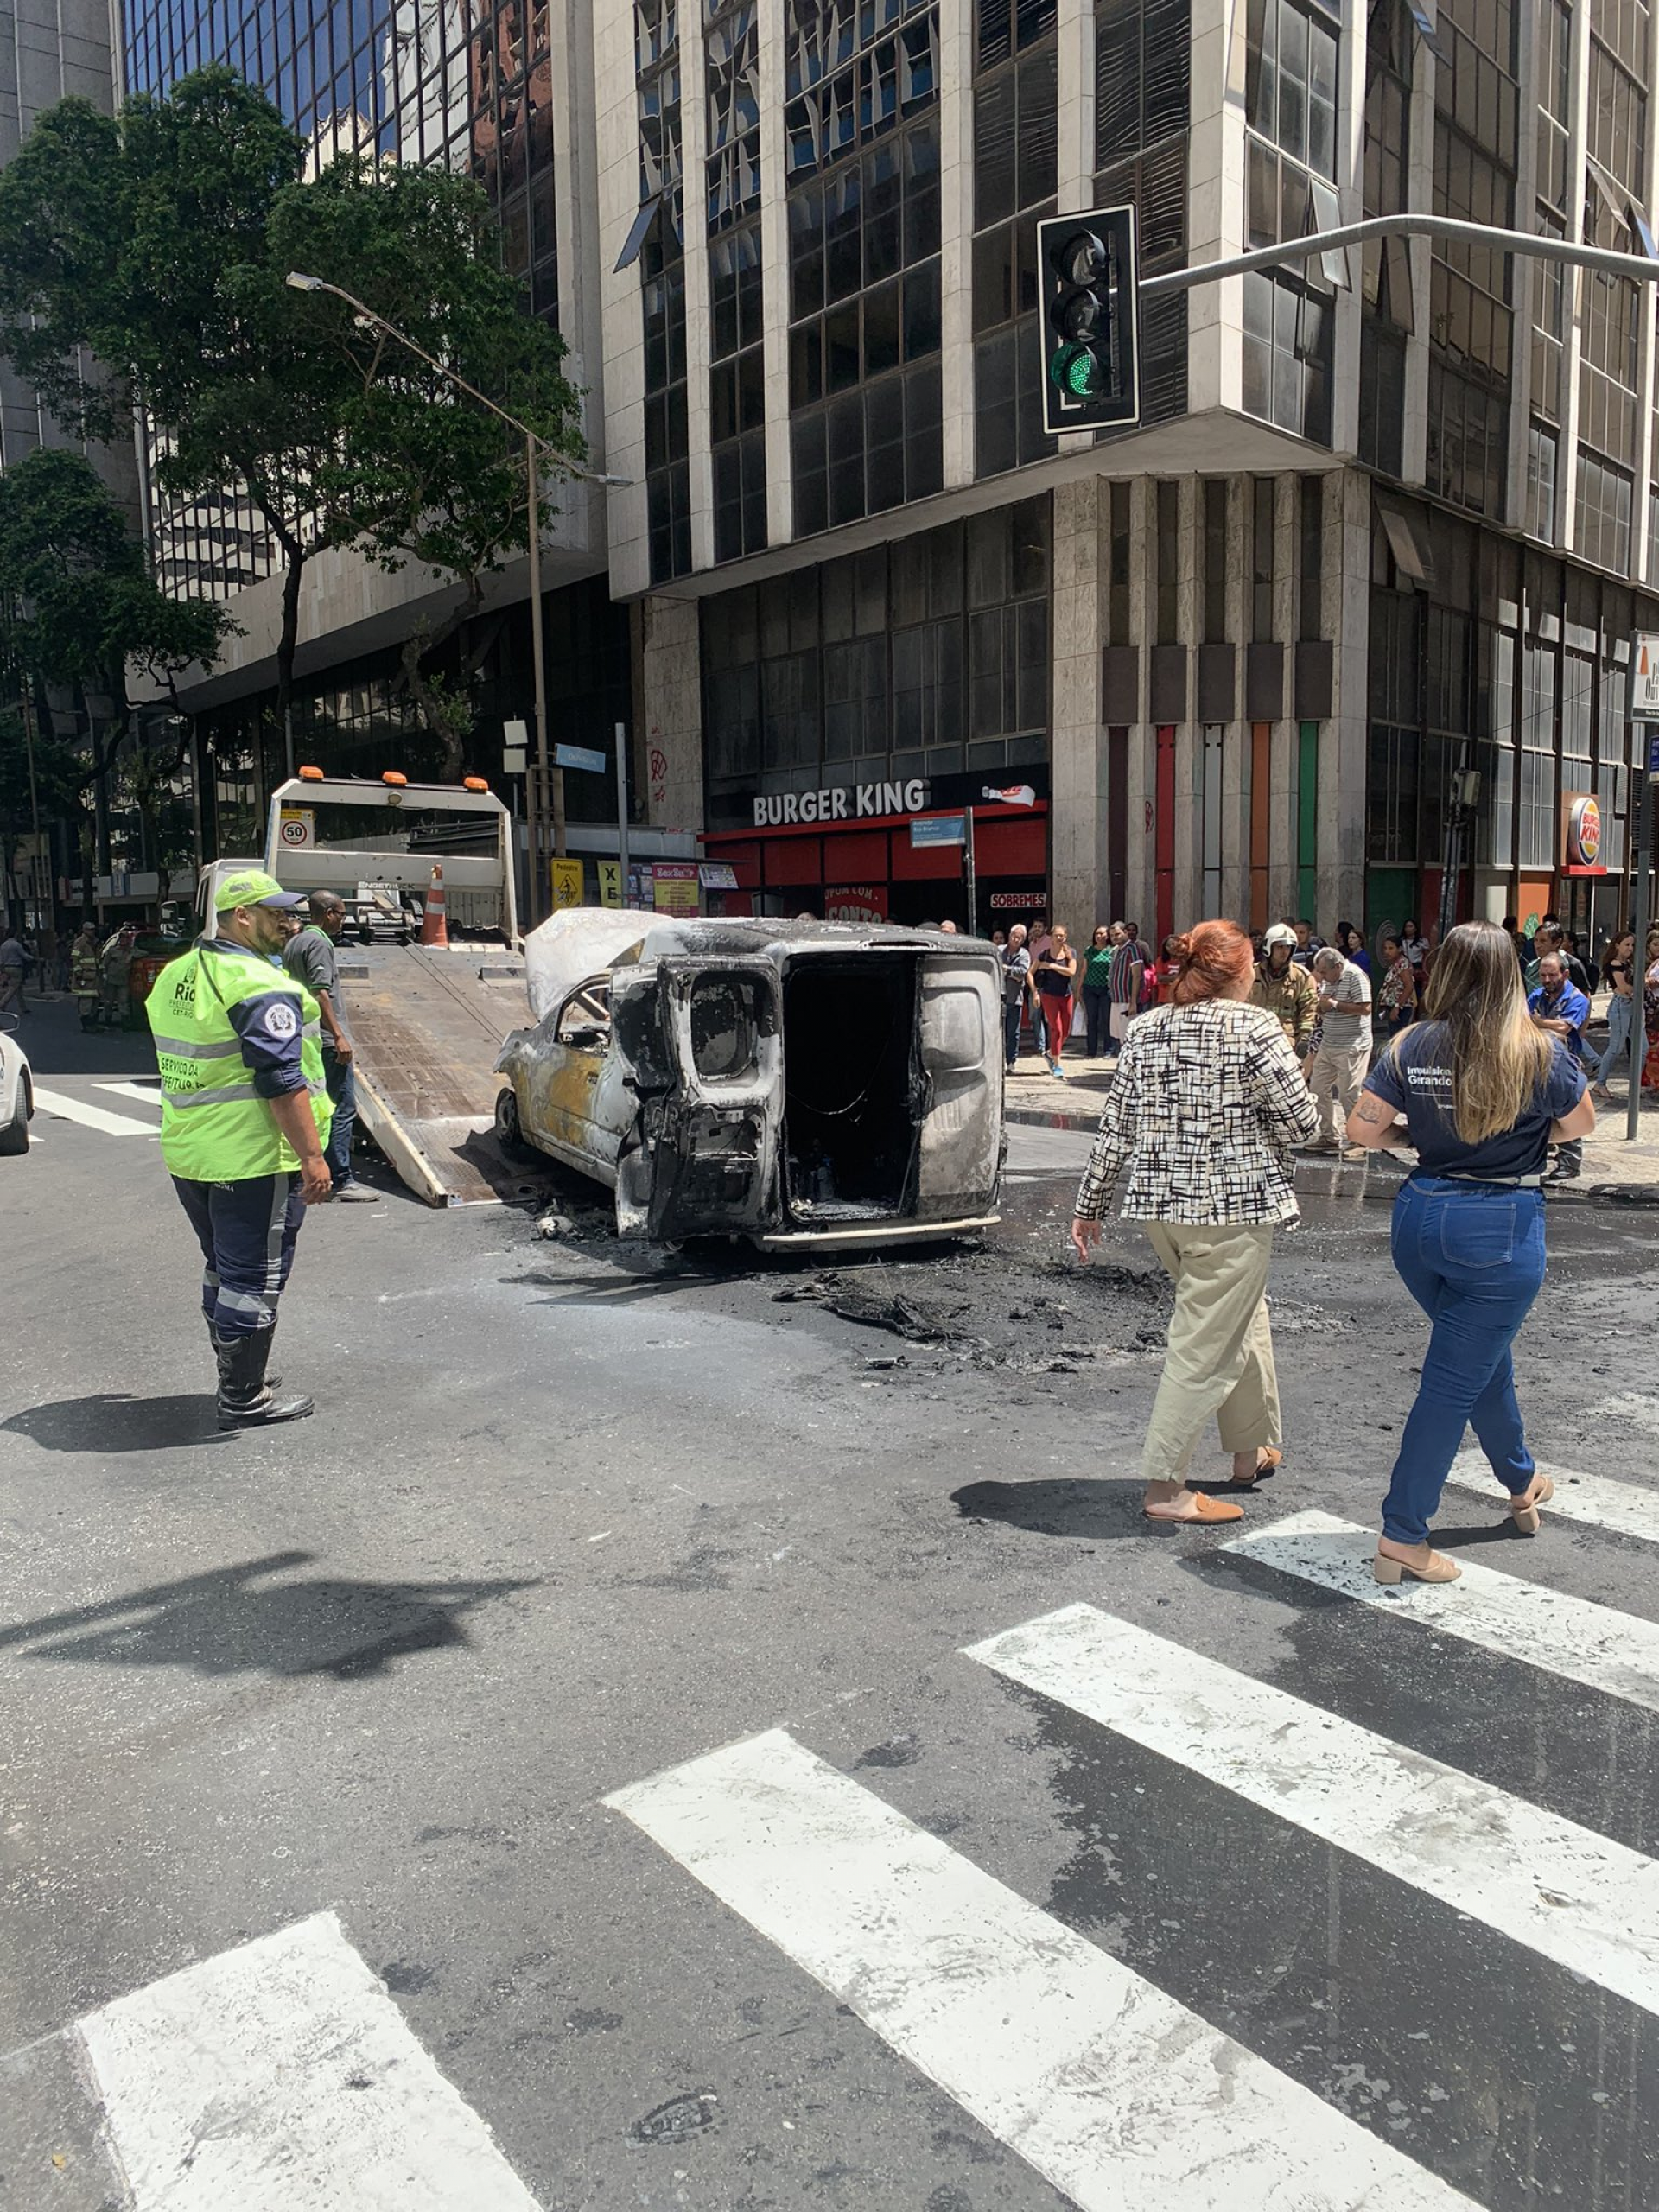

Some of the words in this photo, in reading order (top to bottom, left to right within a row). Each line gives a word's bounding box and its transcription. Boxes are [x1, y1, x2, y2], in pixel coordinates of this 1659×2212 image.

[753, 787, 848, 826] BURGER
[856, 779, 925, 817] KING
[287, 826, 302, 836] 50
